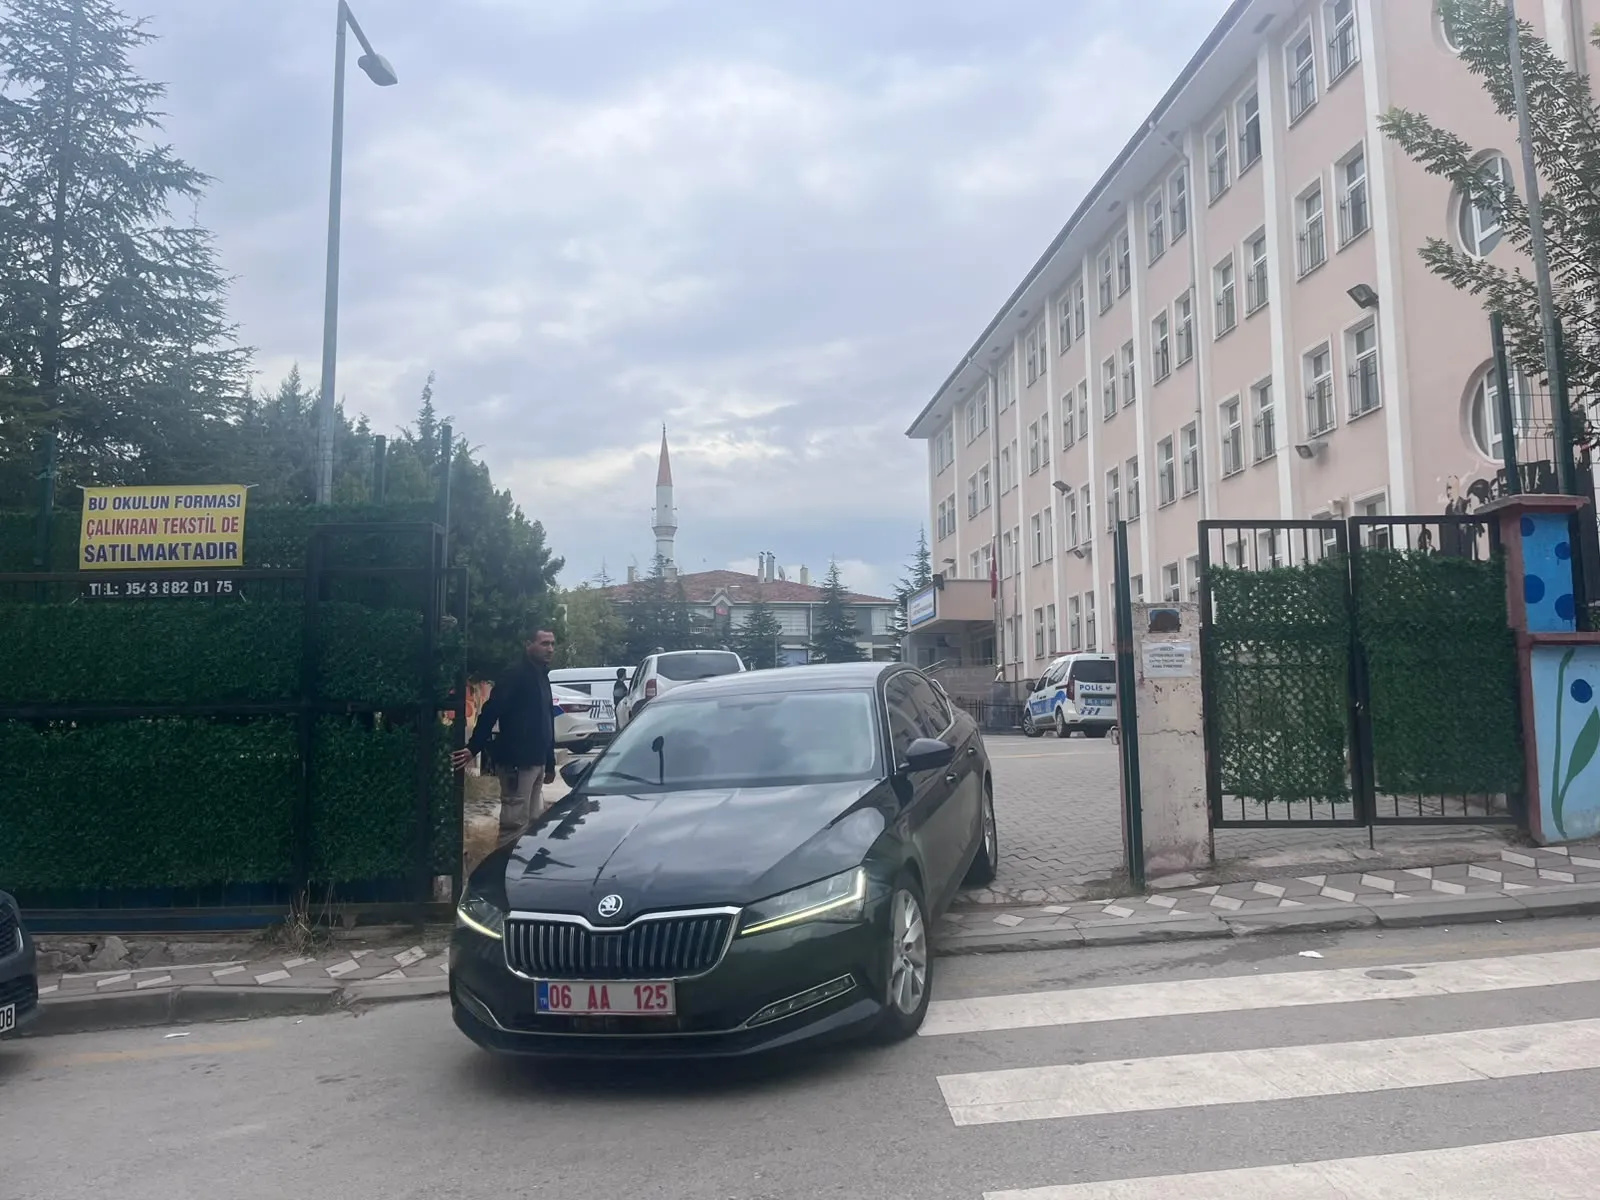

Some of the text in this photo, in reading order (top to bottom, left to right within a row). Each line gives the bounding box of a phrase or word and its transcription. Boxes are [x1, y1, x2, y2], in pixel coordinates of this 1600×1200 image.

[88, 494, 240, 510] BU OKULUN FORMASI
[86, 513, 238, 539] ÇALIKIRAN TEKSTİL DE
[84, 542, 238, 562] SATILMAKTADIR
[162, 581, 188, 594] 882
[194, 581, 208, 593] 01
[216, 580, 232, 593] 75
[550, 984, 572, 1008] 06
[587, 985, 611, 1009] AA
[634, 985, 668, 1009] 125
